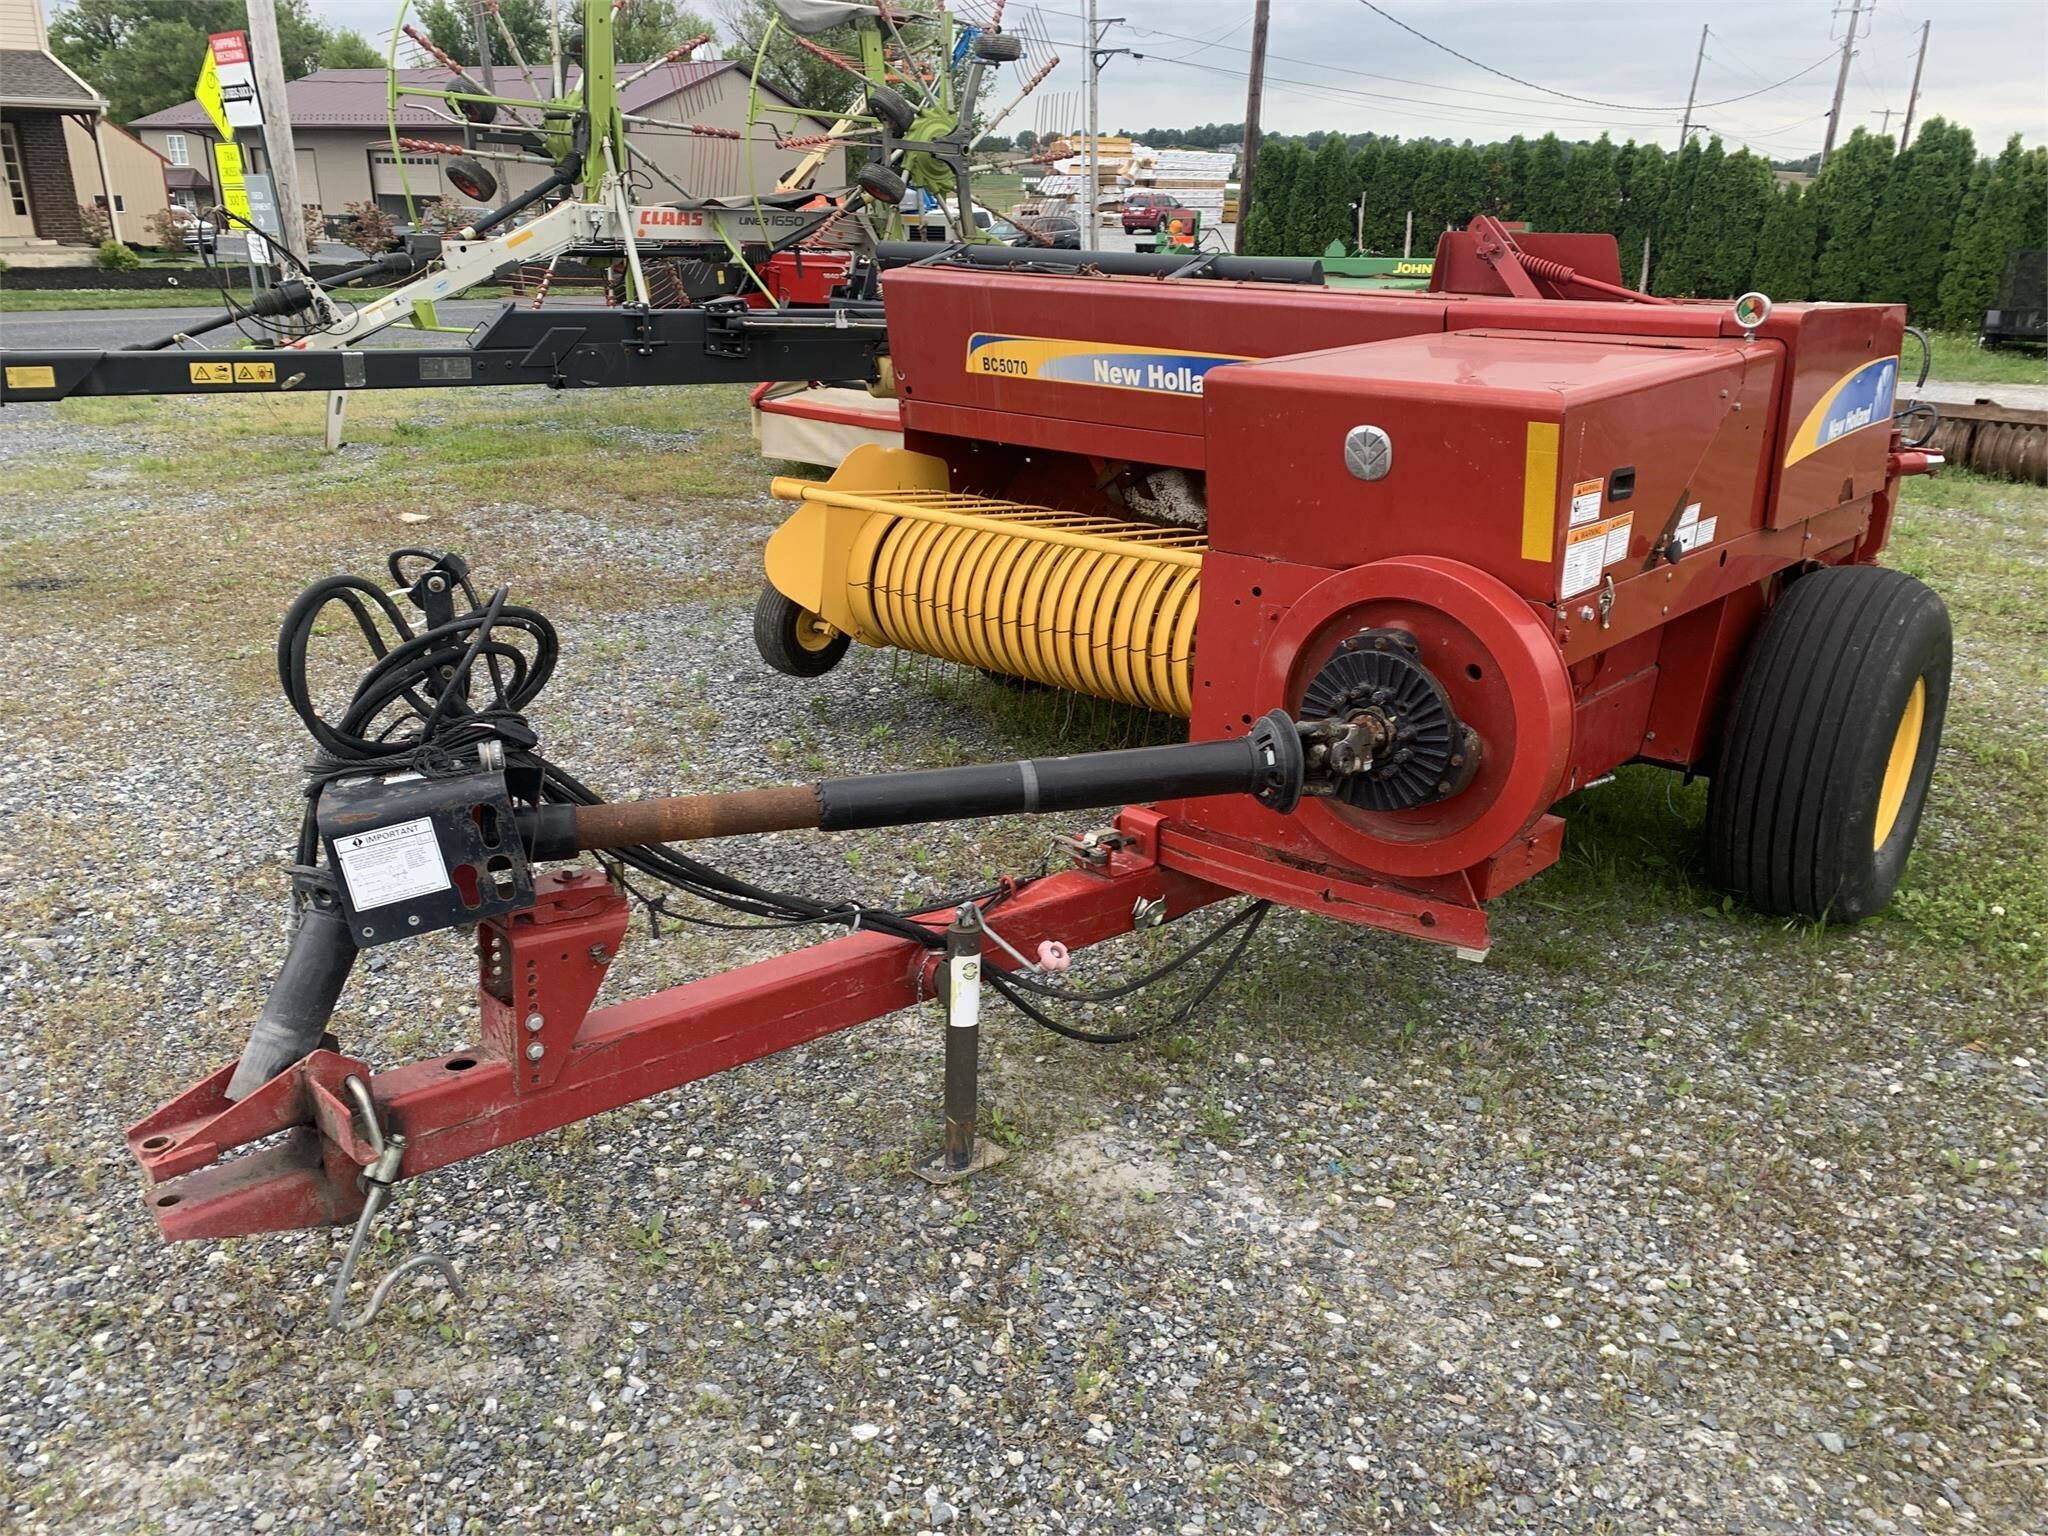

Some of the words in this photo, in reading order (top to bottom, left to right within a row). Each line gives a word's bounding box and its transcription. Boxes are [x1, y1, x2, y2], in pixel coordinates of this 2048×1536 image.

[640, 211, 703, 226] CLAAS
[739, 216, 769, 226] LINER
[771, 215, 805, 227] 1650
[1392, 262, 1432, 274] JOHN
[982, 356, 1028, 376] BC5070
[1093, 359, 1141, 387] New
[1148, 364, 1204, 394] Holla
[1826, 418, 1845, 441] New
[364, 824, 420, 844] IMPORTANT
